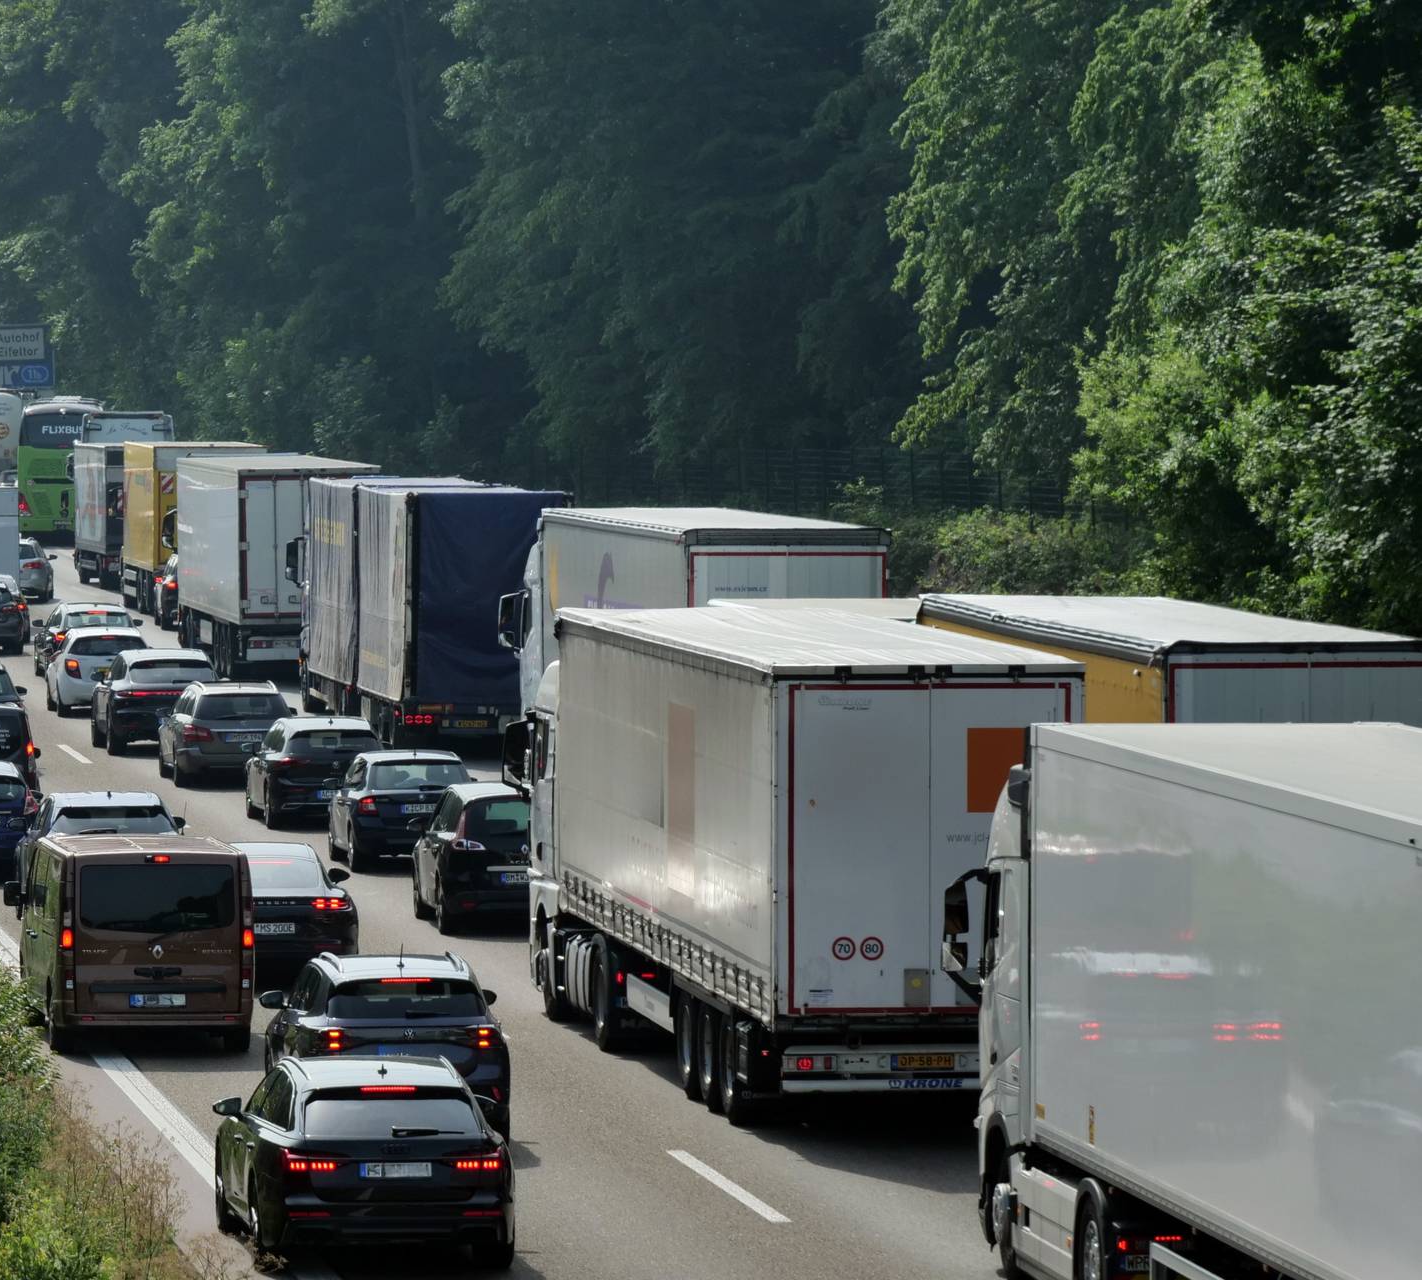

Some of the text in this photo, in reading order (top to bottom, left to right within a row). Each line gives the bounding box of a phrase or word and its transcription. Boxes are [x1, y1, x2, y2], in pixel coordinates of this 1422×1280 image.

[838, 943, 850, 953] 70
[865, 943, 878, 953] 80
[904, 1079, 962, 1089] KRONE
